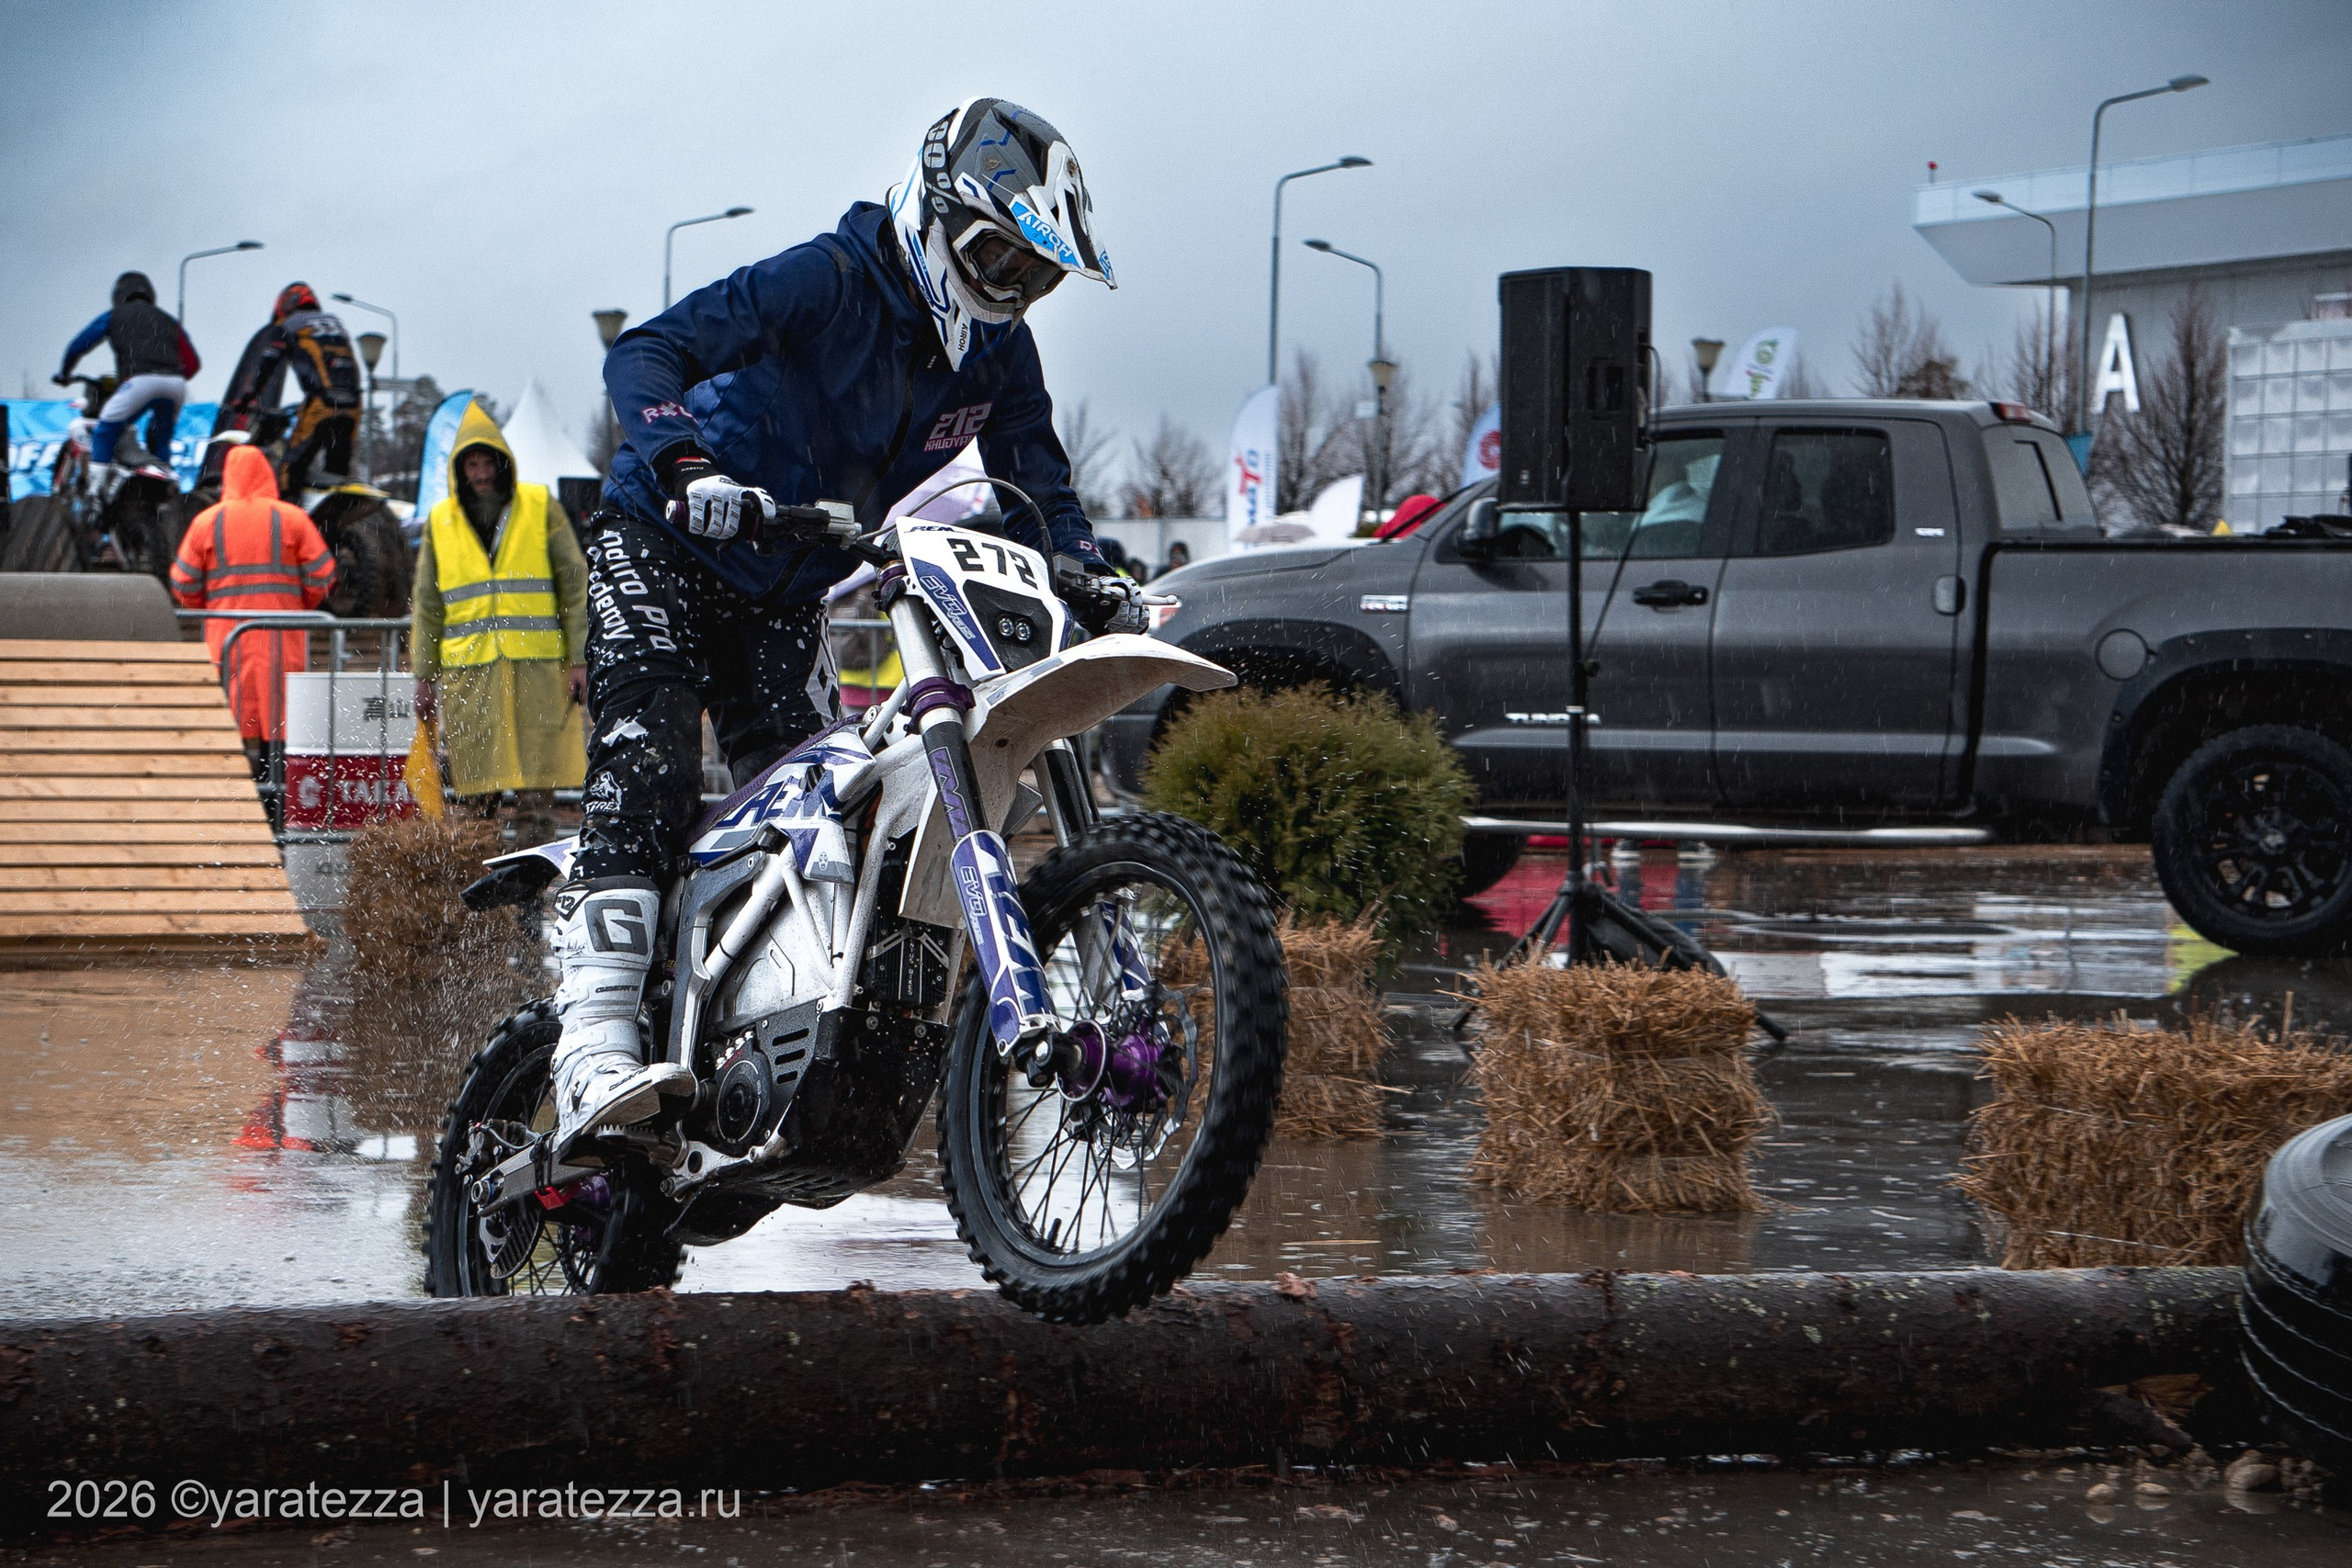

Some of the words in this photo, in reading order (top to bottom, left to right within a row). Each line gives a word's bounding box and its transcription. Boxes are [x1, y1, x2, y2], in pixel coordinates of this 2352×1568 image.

[1018, 212, 1073, 259] AIROH
[957, 323, 968, 352] AIROH
[2090, 312, 2141, 414] A
[924, 435, 973, 452] KHUDYA
[929, 402, 992, 440] 212
[946, 537, 1039, 591] 272
[631, 604, 677, 653] Pro
